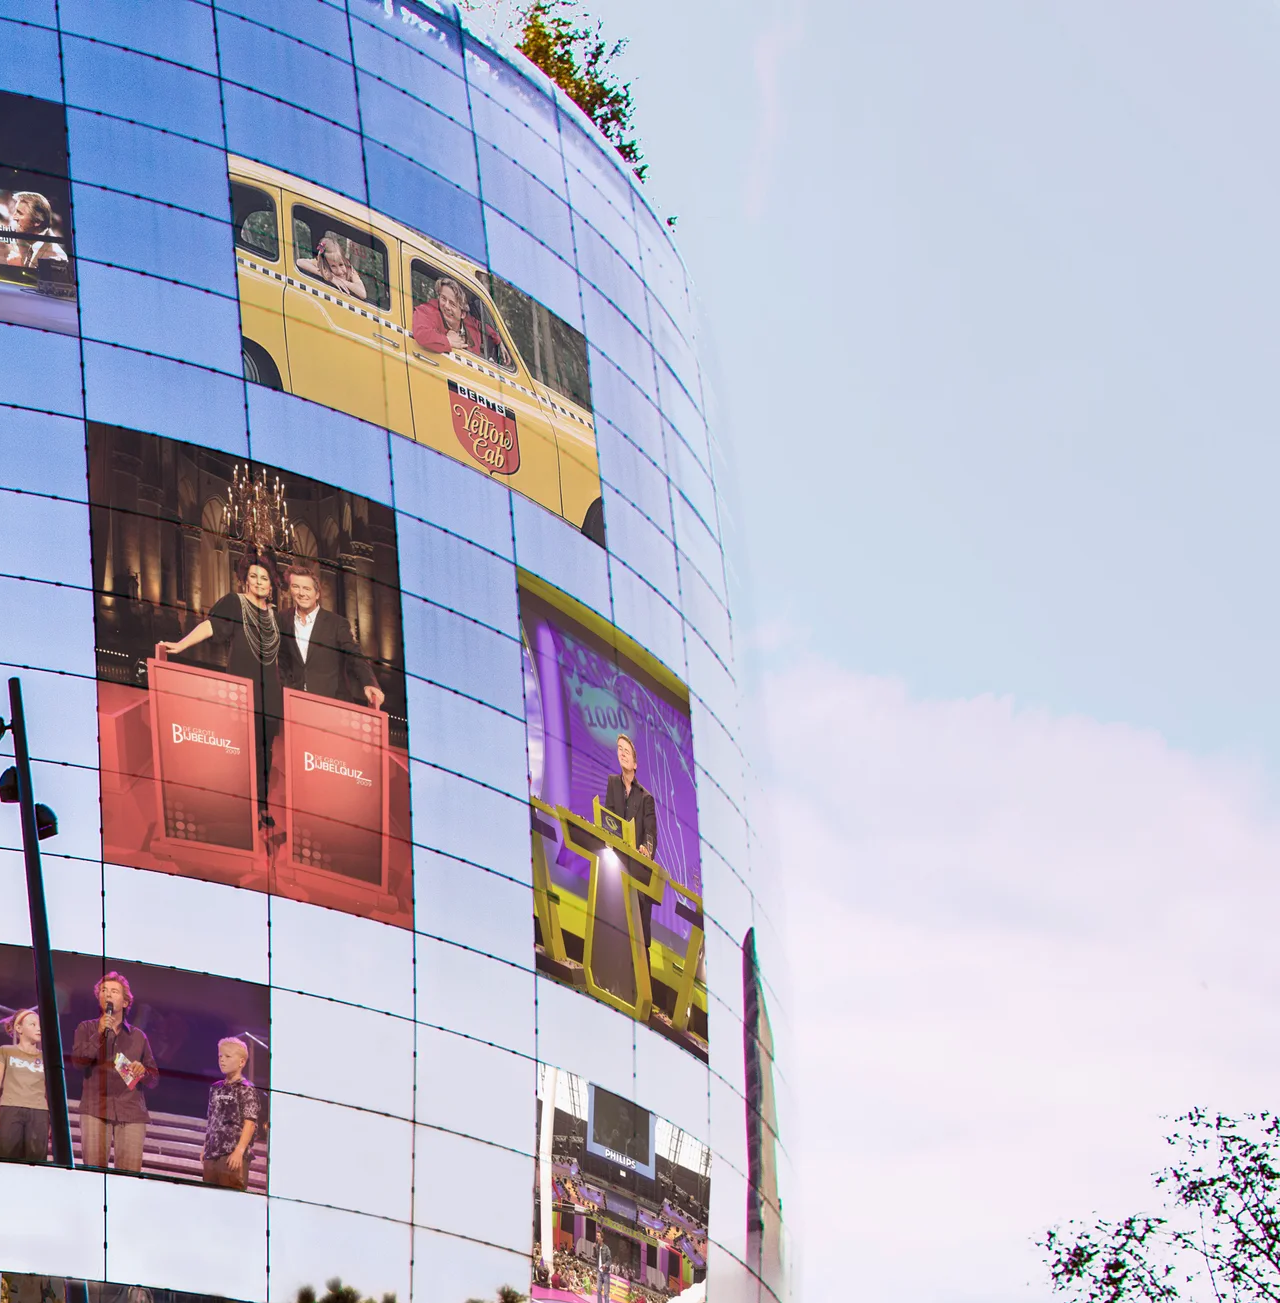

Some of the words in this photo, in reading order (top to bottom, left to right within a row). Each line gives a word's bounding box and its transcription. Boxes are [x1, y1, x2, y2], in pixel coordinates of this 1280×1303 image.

[453, 403, 514, 452] Yellow
[468, 432, 505, 468] Cab
[584, 704, 630, 731] 1000
[604, 1148, 637, 1170] PHILIPS
